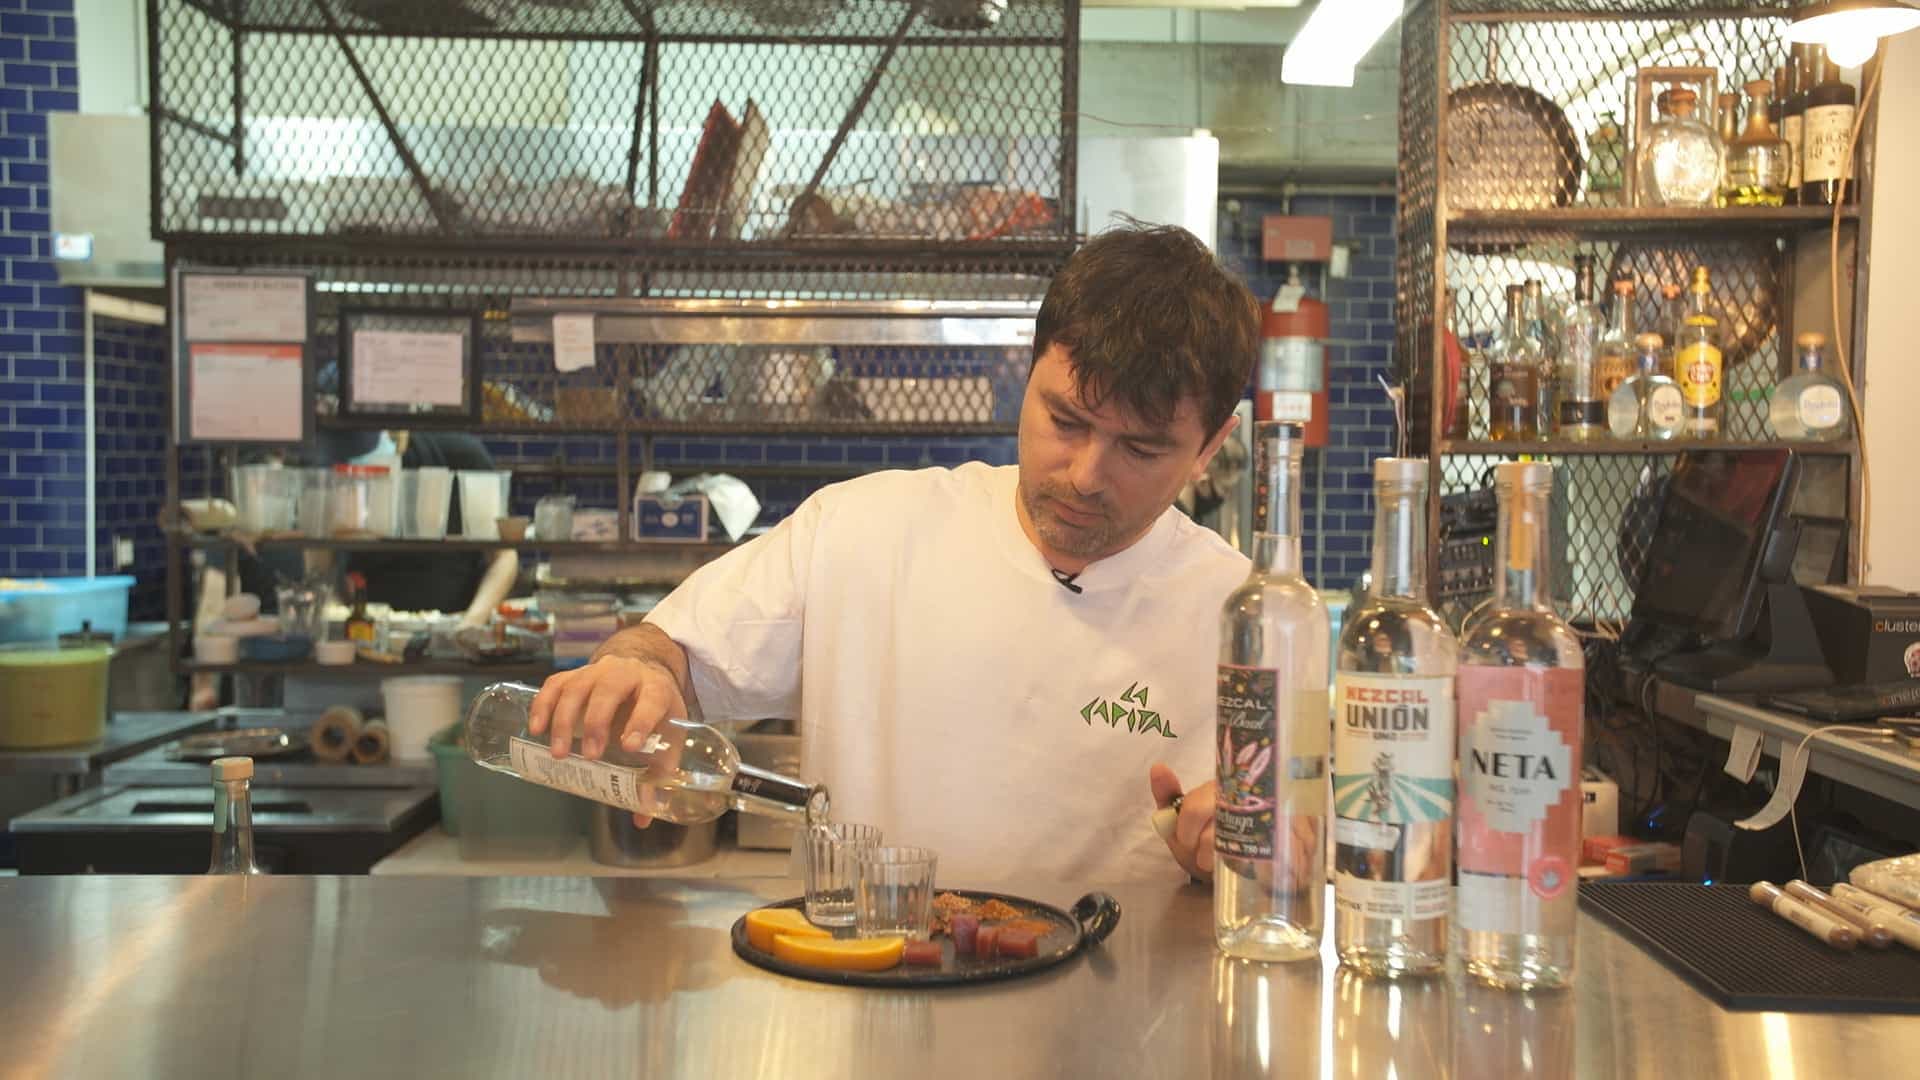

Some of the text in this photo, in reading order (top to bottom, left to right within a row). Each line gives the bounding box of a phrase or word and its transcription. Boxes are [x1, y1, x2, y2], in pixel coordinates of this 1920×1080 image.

[1120, 681, 1148, 708] LA
[1216, 696, 1267, 711] EZCAL
[1345, 686, 1430, 704] MEZCAL
[1080, 696, 1178, 738] CAPITAL
[1346, 704, 1430, 731] UNIÓN
[1471, 748, 1557, 780] NETA
